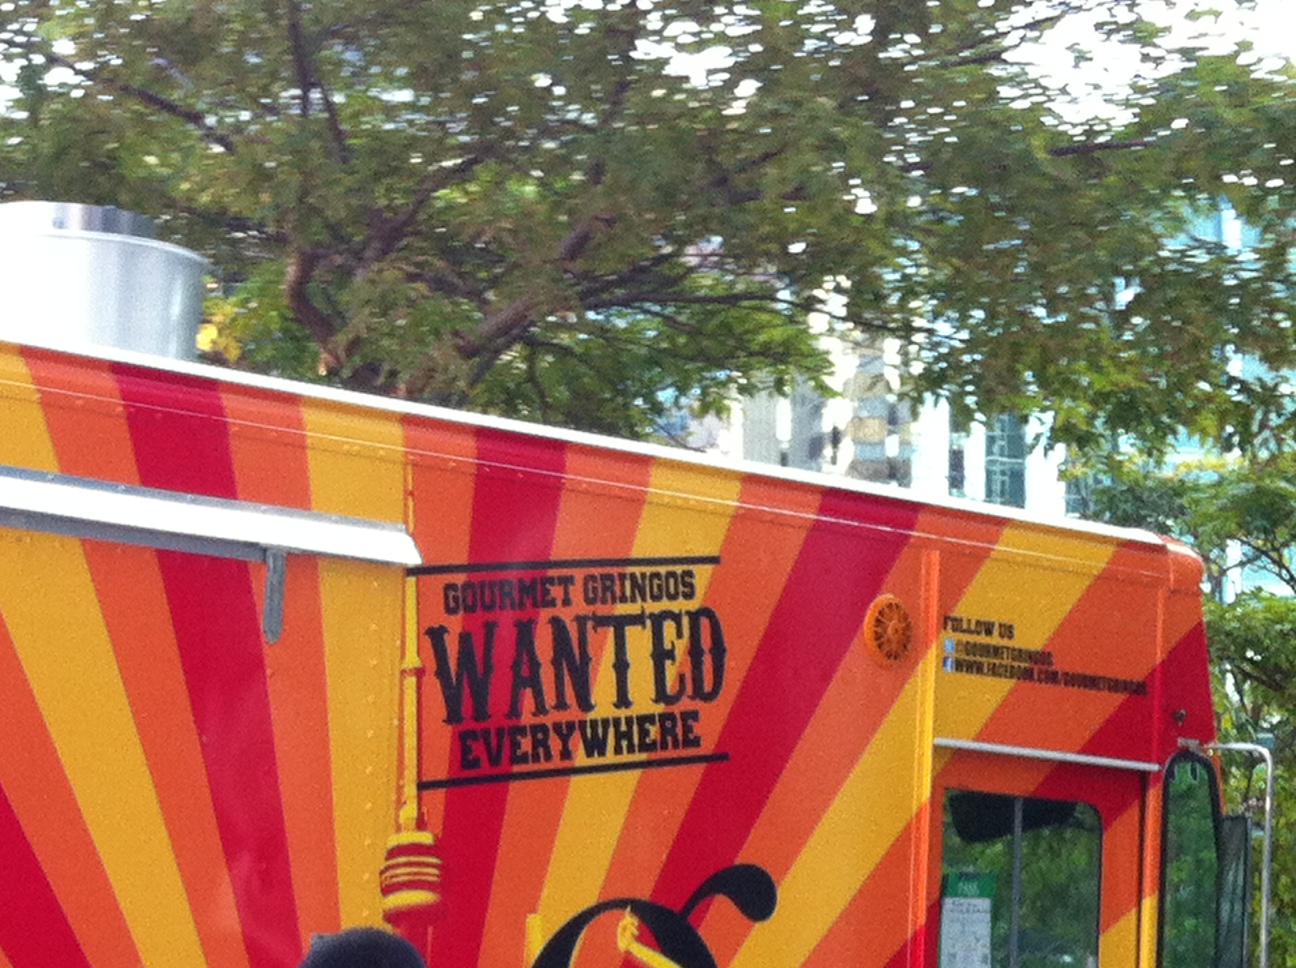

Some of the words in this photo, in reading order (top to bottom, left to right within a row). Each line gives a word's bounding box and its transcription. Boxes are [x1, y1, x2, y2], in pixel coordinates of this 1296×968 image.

[443, 575, 575, 615] GOURMET
[583, 570, 696, 605] GRINGOS
[942, 614, 995, 638] FOLLOW
[998, 620, 1015, 640] US
[424, 606, 727, 725] WANTED
[459, 710, 701, 770] EVERYWHERE
